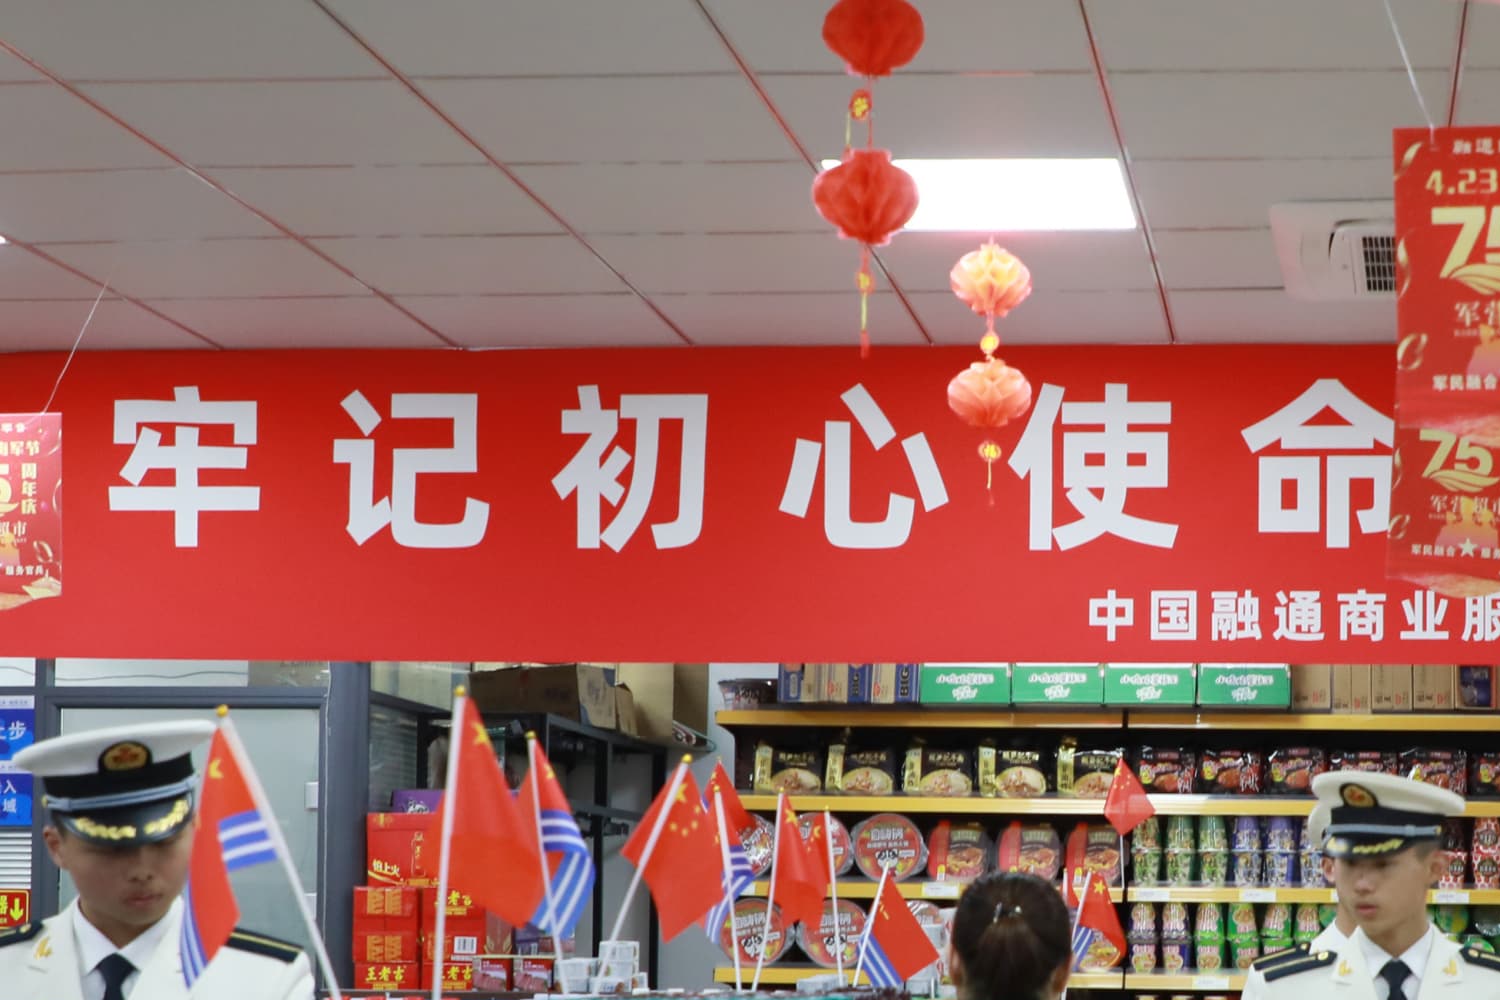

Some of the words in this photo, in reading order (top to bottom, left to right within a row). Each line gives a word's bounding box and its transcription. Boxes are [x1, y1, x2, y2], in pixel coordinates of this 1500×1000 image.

[1425, 167, 1498, 195] 4.23
[364, 965, 407, 982] 王老吉
